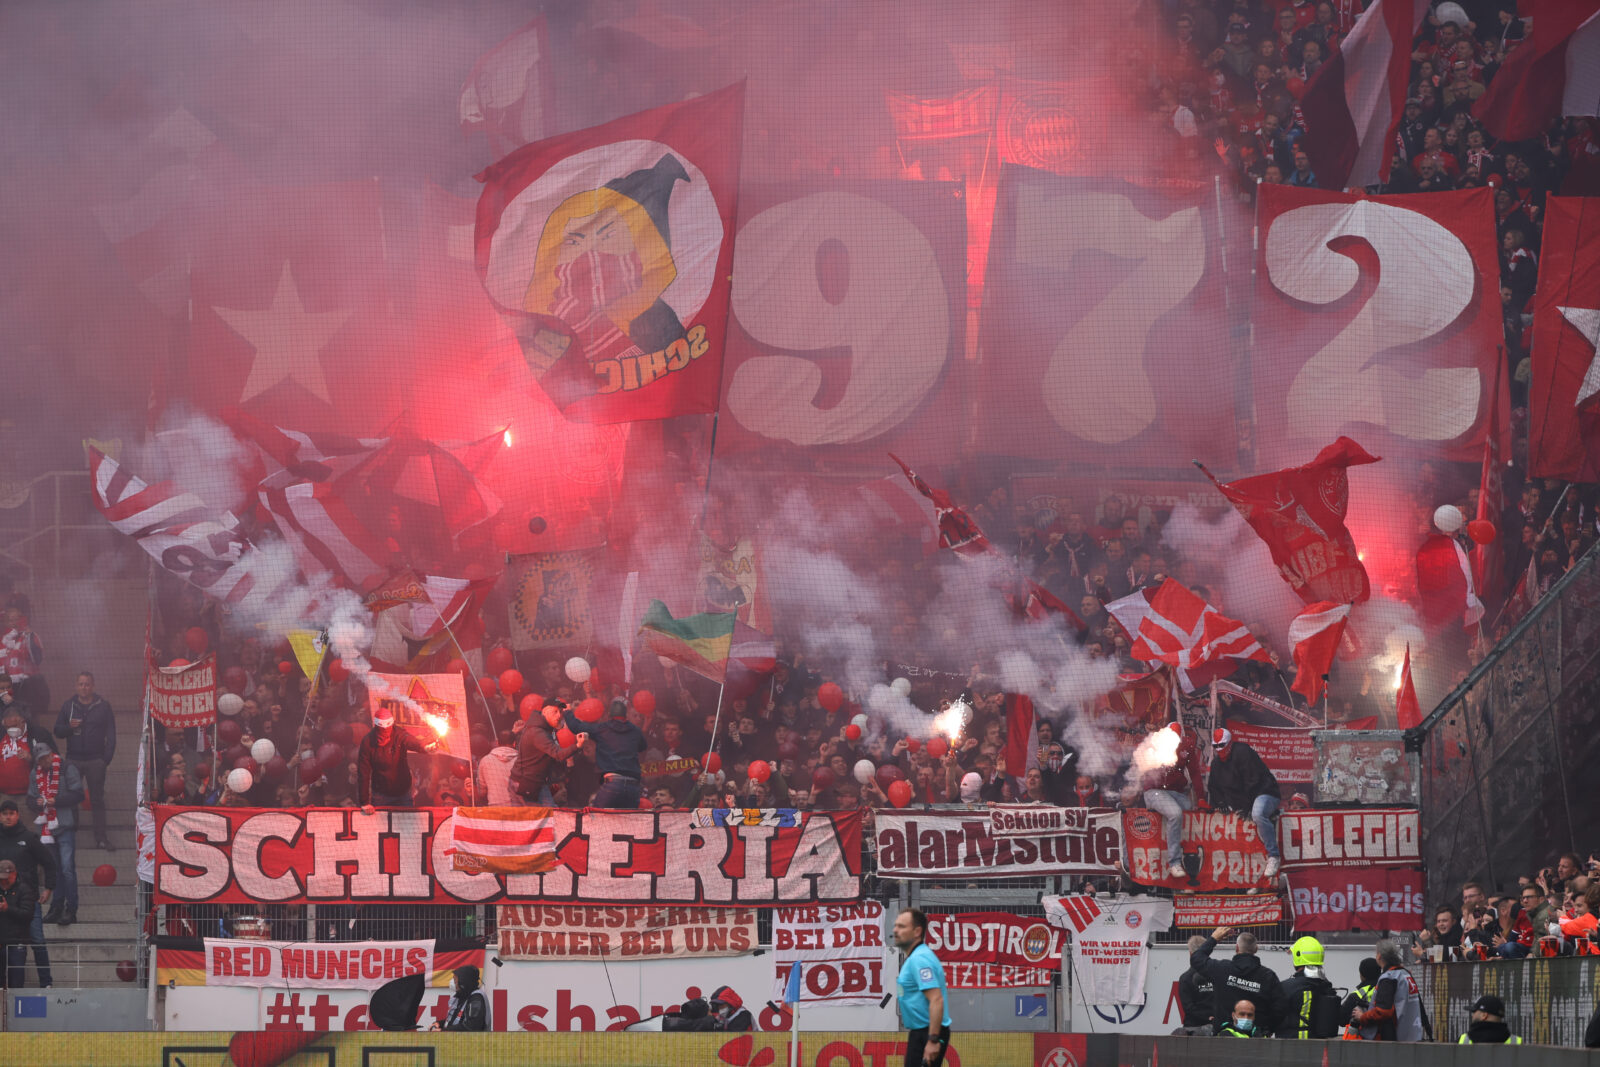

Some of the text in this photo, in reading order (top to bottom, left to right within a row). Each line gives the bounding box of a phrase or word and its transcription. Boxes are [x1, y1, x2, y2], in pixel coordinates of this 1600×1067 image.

[992, 809, 1088, 831] Sektion SV
[1281, 813, 1419, 860] COLEGIO
[1212, 850, 1278, 886] PRID
[776, 901, 882, 923] WIR SIND
[1293, 884, 1425, 915] Rhoibazis
[1177, 911, 1280, 924] IMMER ANWESEND
[501, 927, 751, 956] IMMER BEI UNS
[776, 924, 882, 950] BEI DIR
[213, 946, 271, 977] RED
[776, 961, 883, 996] TOBI
